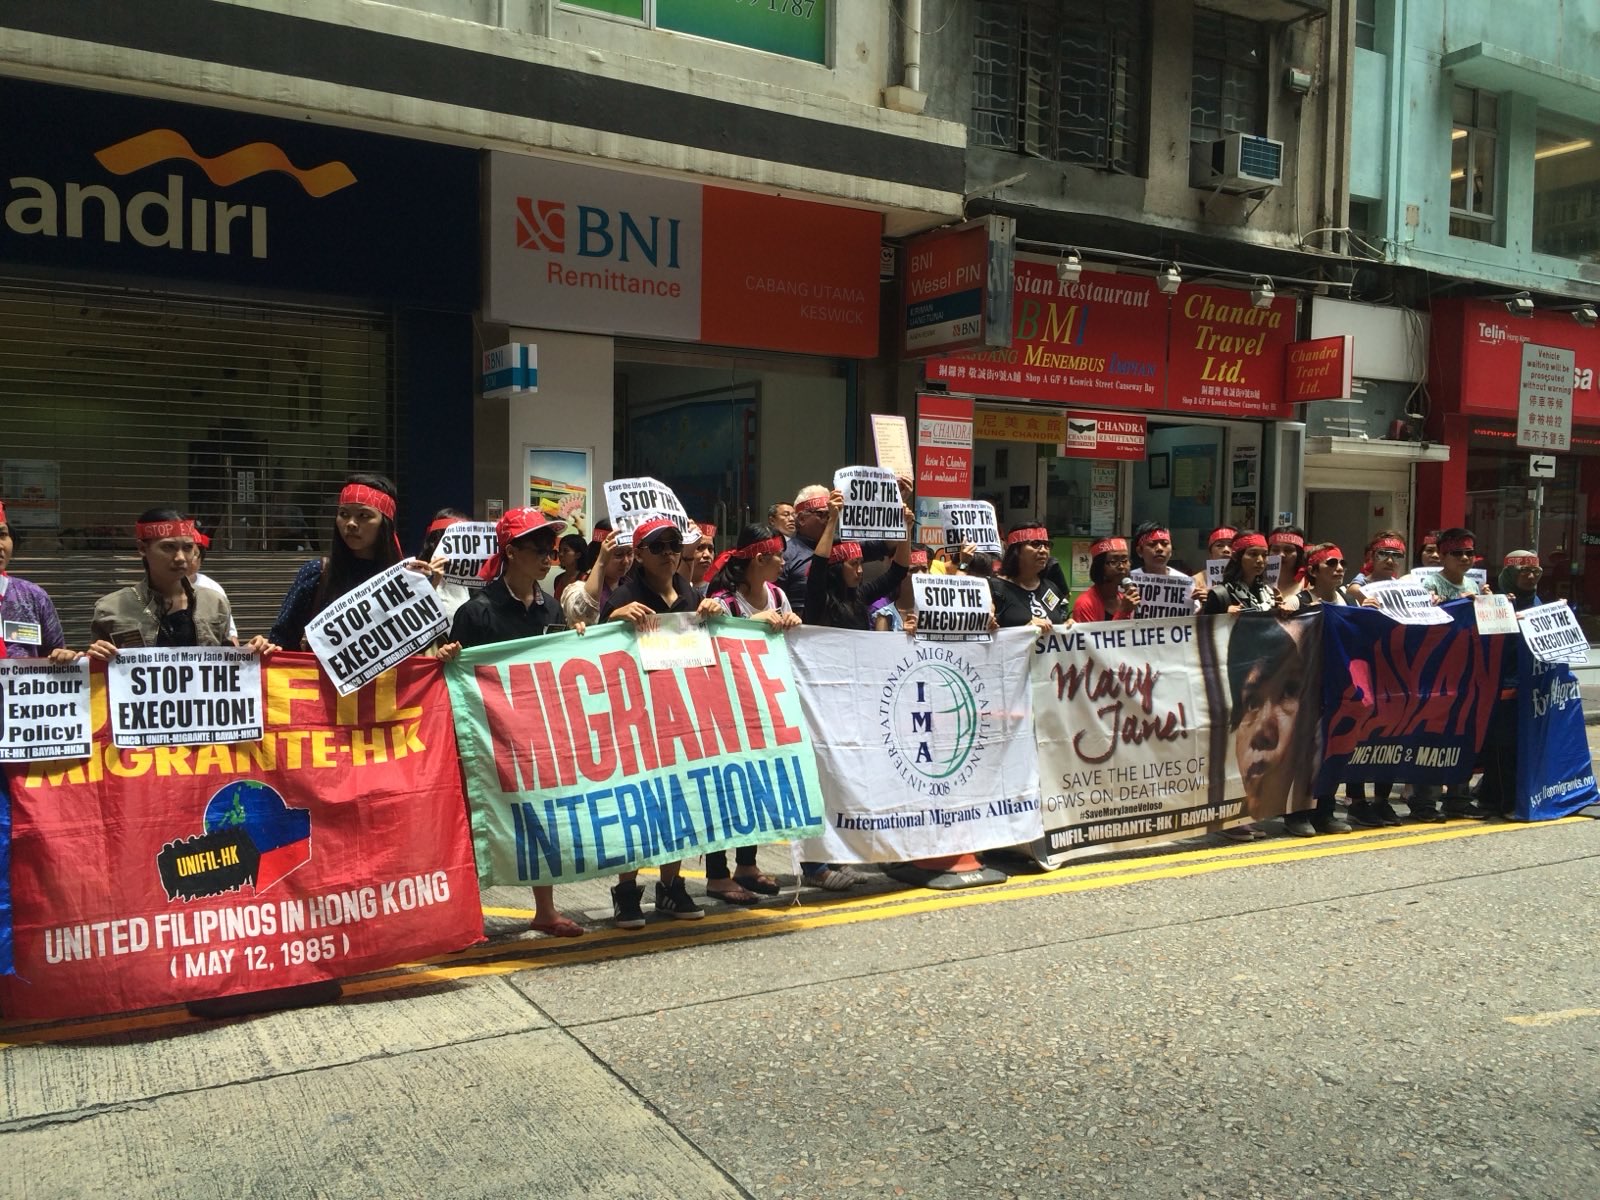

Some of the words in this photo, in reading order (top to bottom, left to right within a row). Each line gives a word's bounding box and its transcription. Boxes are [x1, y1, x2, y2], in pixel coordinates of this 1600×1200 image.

[577, 205, 681, 268] BNI
[912, 251, 933, 273] BNI
[547, 261, 681, 298] Remittance
[745, 275, 808, 297] CABANG
[813, 284, 865, 304] UTAMA
[912, 271, 951, 297] Wesel
[956, 263, 981, 286] PIN
[1058, 279, 1151, 308] Restaurant
[800, 304, 864, 325] KESWICK
[1016, 299, 1089, 346] BMI
[1184, 293, 1281, 329] Chandra
[961, 320, 979, 336] BNI
[1479, 323, 1506, 340] Telin
[1195, 325, 1265, 356] Travel
[491, 350, 504, 369] BNI
[1291, 346, 1338, 364] Chandra
[1527, 360, 1550, 371] waiting
[1550, 363, 1562, 372] will
[1562, 364, 1569, 373] be
[1538, 350, 1560, 360] Vehicle
[1200, 356, 1246, 384] Ltd.
[1296, 363, 1330, 378] Travel
[1530, 371, 1565, 383] prosecuted
[1095, 379, 1113, 389] Street
[1299, 381, 1321, 395] Ltd.
[1522, 381, 1547, 391] without
[1547, 384, 1572, 396] warning
[933, 423, 972, 439] CHANDRA
[1097, 420, 1144, 433] CHANDRA
[620, 489, 658, 512] STOP
[659, 491, 680, 512] THE
[850, 479, 878, 502] STOP
[880, 481, 898, 503] THE
[842, 504, 904, 528] EXECUTION!
[950, 510, 977, 526] STOP
[441, 534, 481, 555] STOP
[924, 586, 956, 607] STOP
[958, 588, 983, 608] THE
[1137, 584, 1161, 602] TOP
[1163, 585, 1186, 605] THE
[310, 617, 325, 632] Save
[323, 610, 335, 622] the
[334, 601, 348, 614] Life
[347, 595, 356, 605] of
[354, 587, 372, 601] Mary
[322, 599, 372, 647] STOP
[371, 573, 416, 613] THE
[917, 610, 990, 631] EXECUTION!
[1529, 615, 1553, 634] STOP
[1552, 610, 1571, 628] THE
[327, 593, 443, 681] EXECUTION!
[1035, 632, 1086, 655] SAVE
[1091, 629, 1127, 650] THE
[1132, 626, 1167, 647] LIFE
[1171, 624, 1193, 643] OF
[115, 653, 137, 665] Save
[138, 652, 153, 663] the
[154, 652, 171, 663] Life
[171, 652, 181, 662] of
[181, 652, 202, 663] Mary
[203, 651, 223, 662] Jane
[8, 679, 83, 696] Labour
[130, 665, 194, 695] STOP
[198, 665, 241, 693] THE
[1050, 656, 1161, 715] Mary
[8, 702, 77, 720] Export
[118, 697, 256, 730] EXECUTION!
[474, 637, 802, 792] MIGRANTE
[915, 647, 987, 695] MIGRANTS
[959, 697, 992, 786] ALLIANCE
[9, 723, 83, 743] Policy!
[1073, 699, 1189, 765] Jane!
[1370, 744, 1403, 765] KONG
[1404, 748, 1413, 762] &
[1415, 746, 1461, 768] MACAU
[1062, 769, 1102, 790] SAVE
[1107, 765, 1137, 783] THE
[1143, 760, 1182, 780] LIVES
[1186, 756, 1206, 774] OF
[928, 781, 951, 796] 2008
[1047, 792, 1086, 813] OFWS
[1089, 788, 1114, 806] ON
[1119, 776, 1206, 802] DEATHROW!
[511, 755, 822, 881] INTERNATIONAL
[836, 811, 926, 830] International
[929, 809, 982, 828] Migrants
[1080, 801, 1163, 820] #SaveMaryJaneVeloso
[1051, 817, 1173, 850] UNIFIL-MIGRANTE-HK
[176, 845, 240, 878] UNIFIL-HK
[44, 920, 150, 965] UNITED
[156, 901, 278, 948] FILIPINOS
[280, 899, 305, 934] IN
[308, 888, 379, 928] HONG
[382, 870, 451, 916] KONG
[243, 945, 275, 973] 12,
